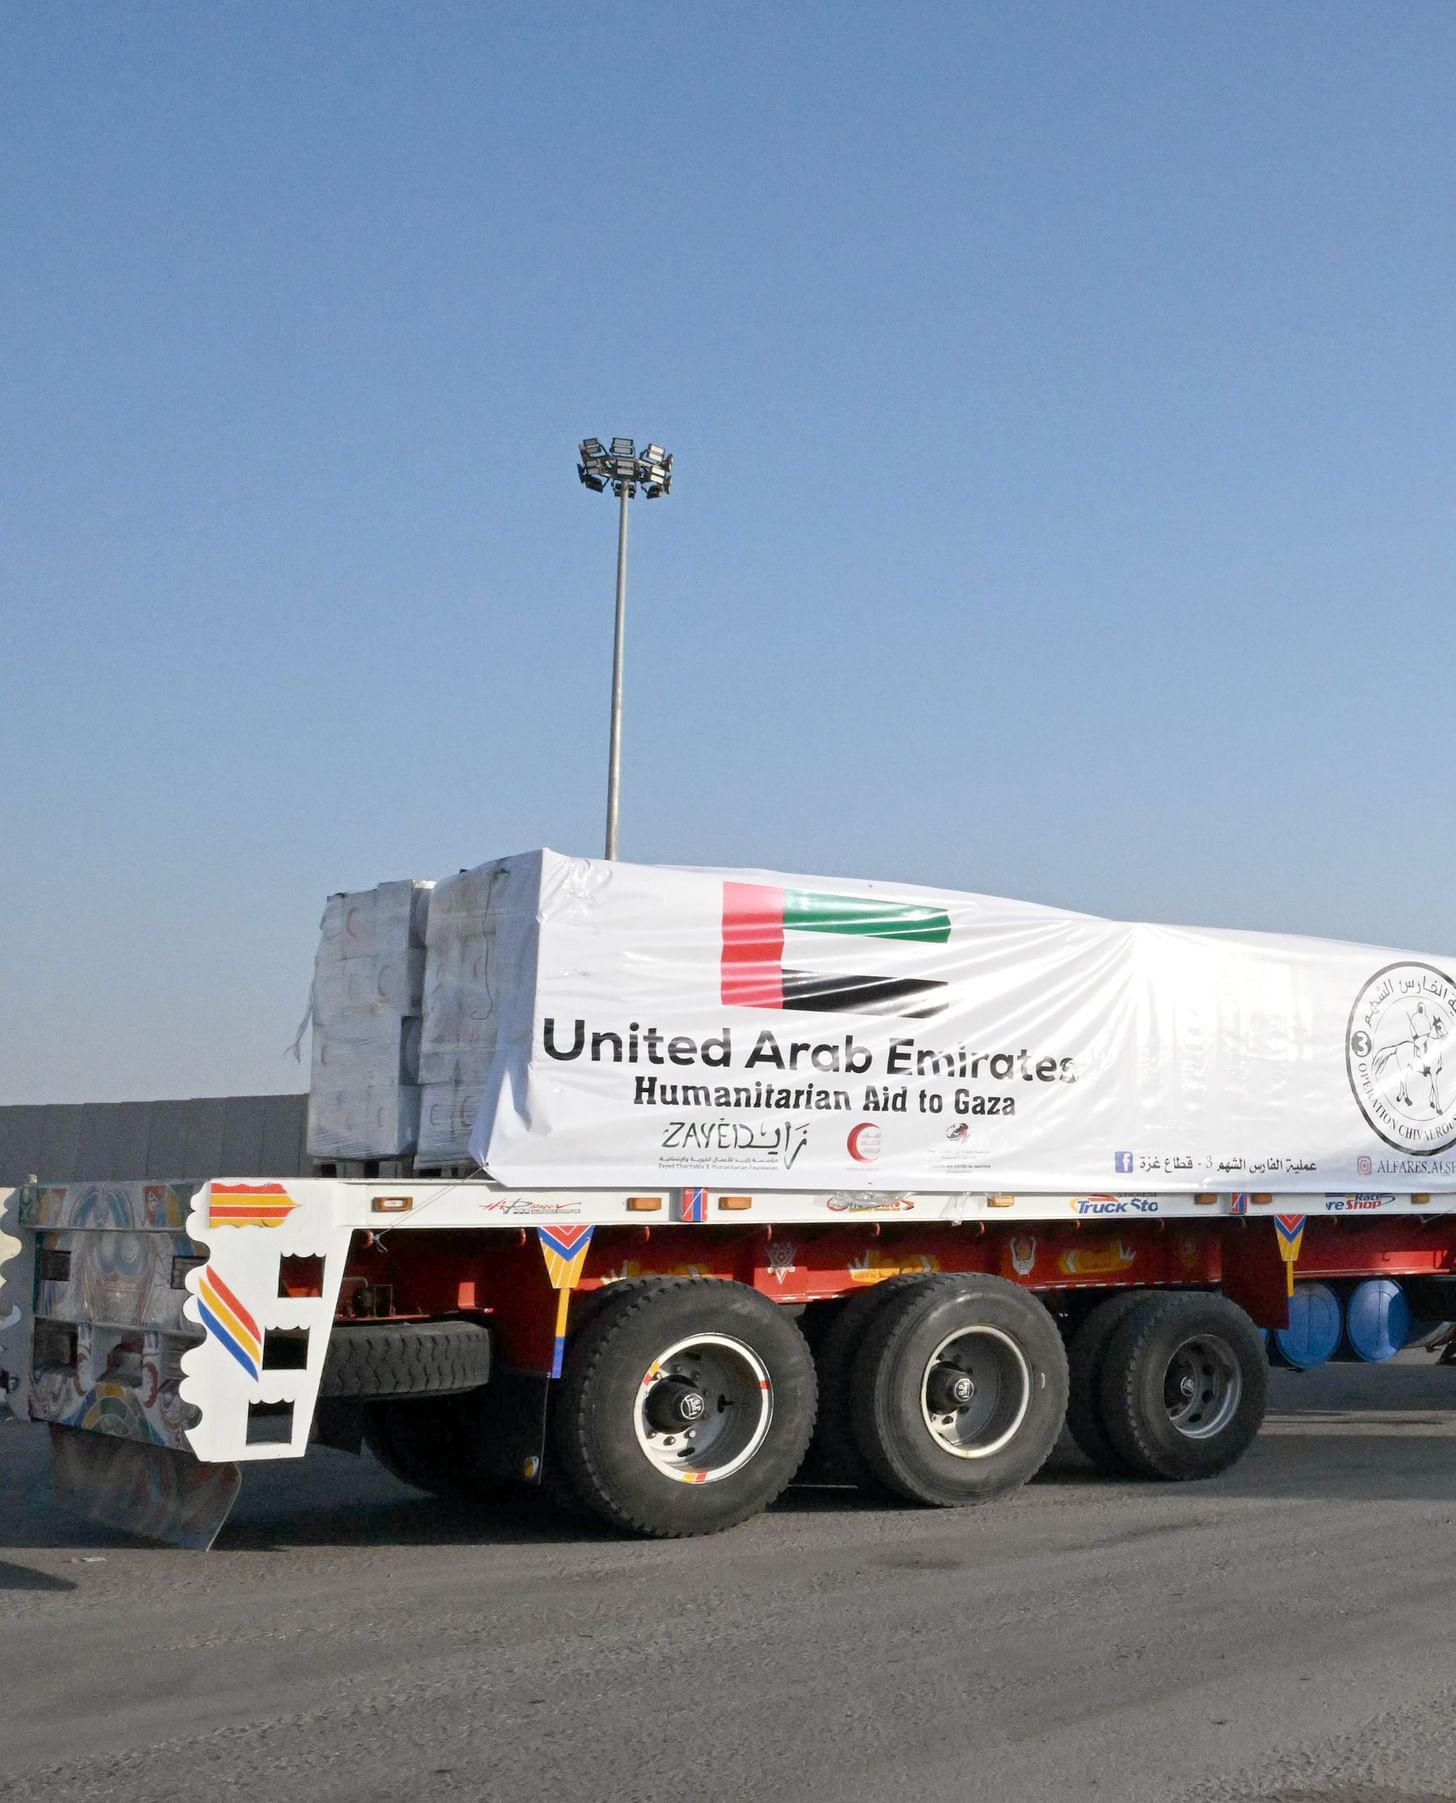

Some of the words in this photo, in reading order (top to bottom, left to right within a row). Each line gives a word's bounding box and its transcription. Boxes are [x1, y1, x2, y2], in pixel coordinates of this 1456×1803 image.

[1399, 976, 1447, 999] الفارس
[543, 1017, 732, 1068] United
[744, 1029, 873, 1074] Arab
[886, 1036, 1080, 1084] Emirates
[633, 1076, 852, 1111] Humanitarian
[862, 1085, 908, 1112] Aid
[919, 1089, 943, 1114] to
[954, 1088, 1016, 1116] Gaza
[1358, 1062, 1399, 1131] OPERATION
[1139, 1156, 1161, 1174] غزة
[1165, 1156, 1193, 1174] قطاع
[1217, 1157, 1246, 1174] الشهم
[1250, 1157, 1283, 1174] الفارس
[1286, 1157, 1317, 1174] عملية
